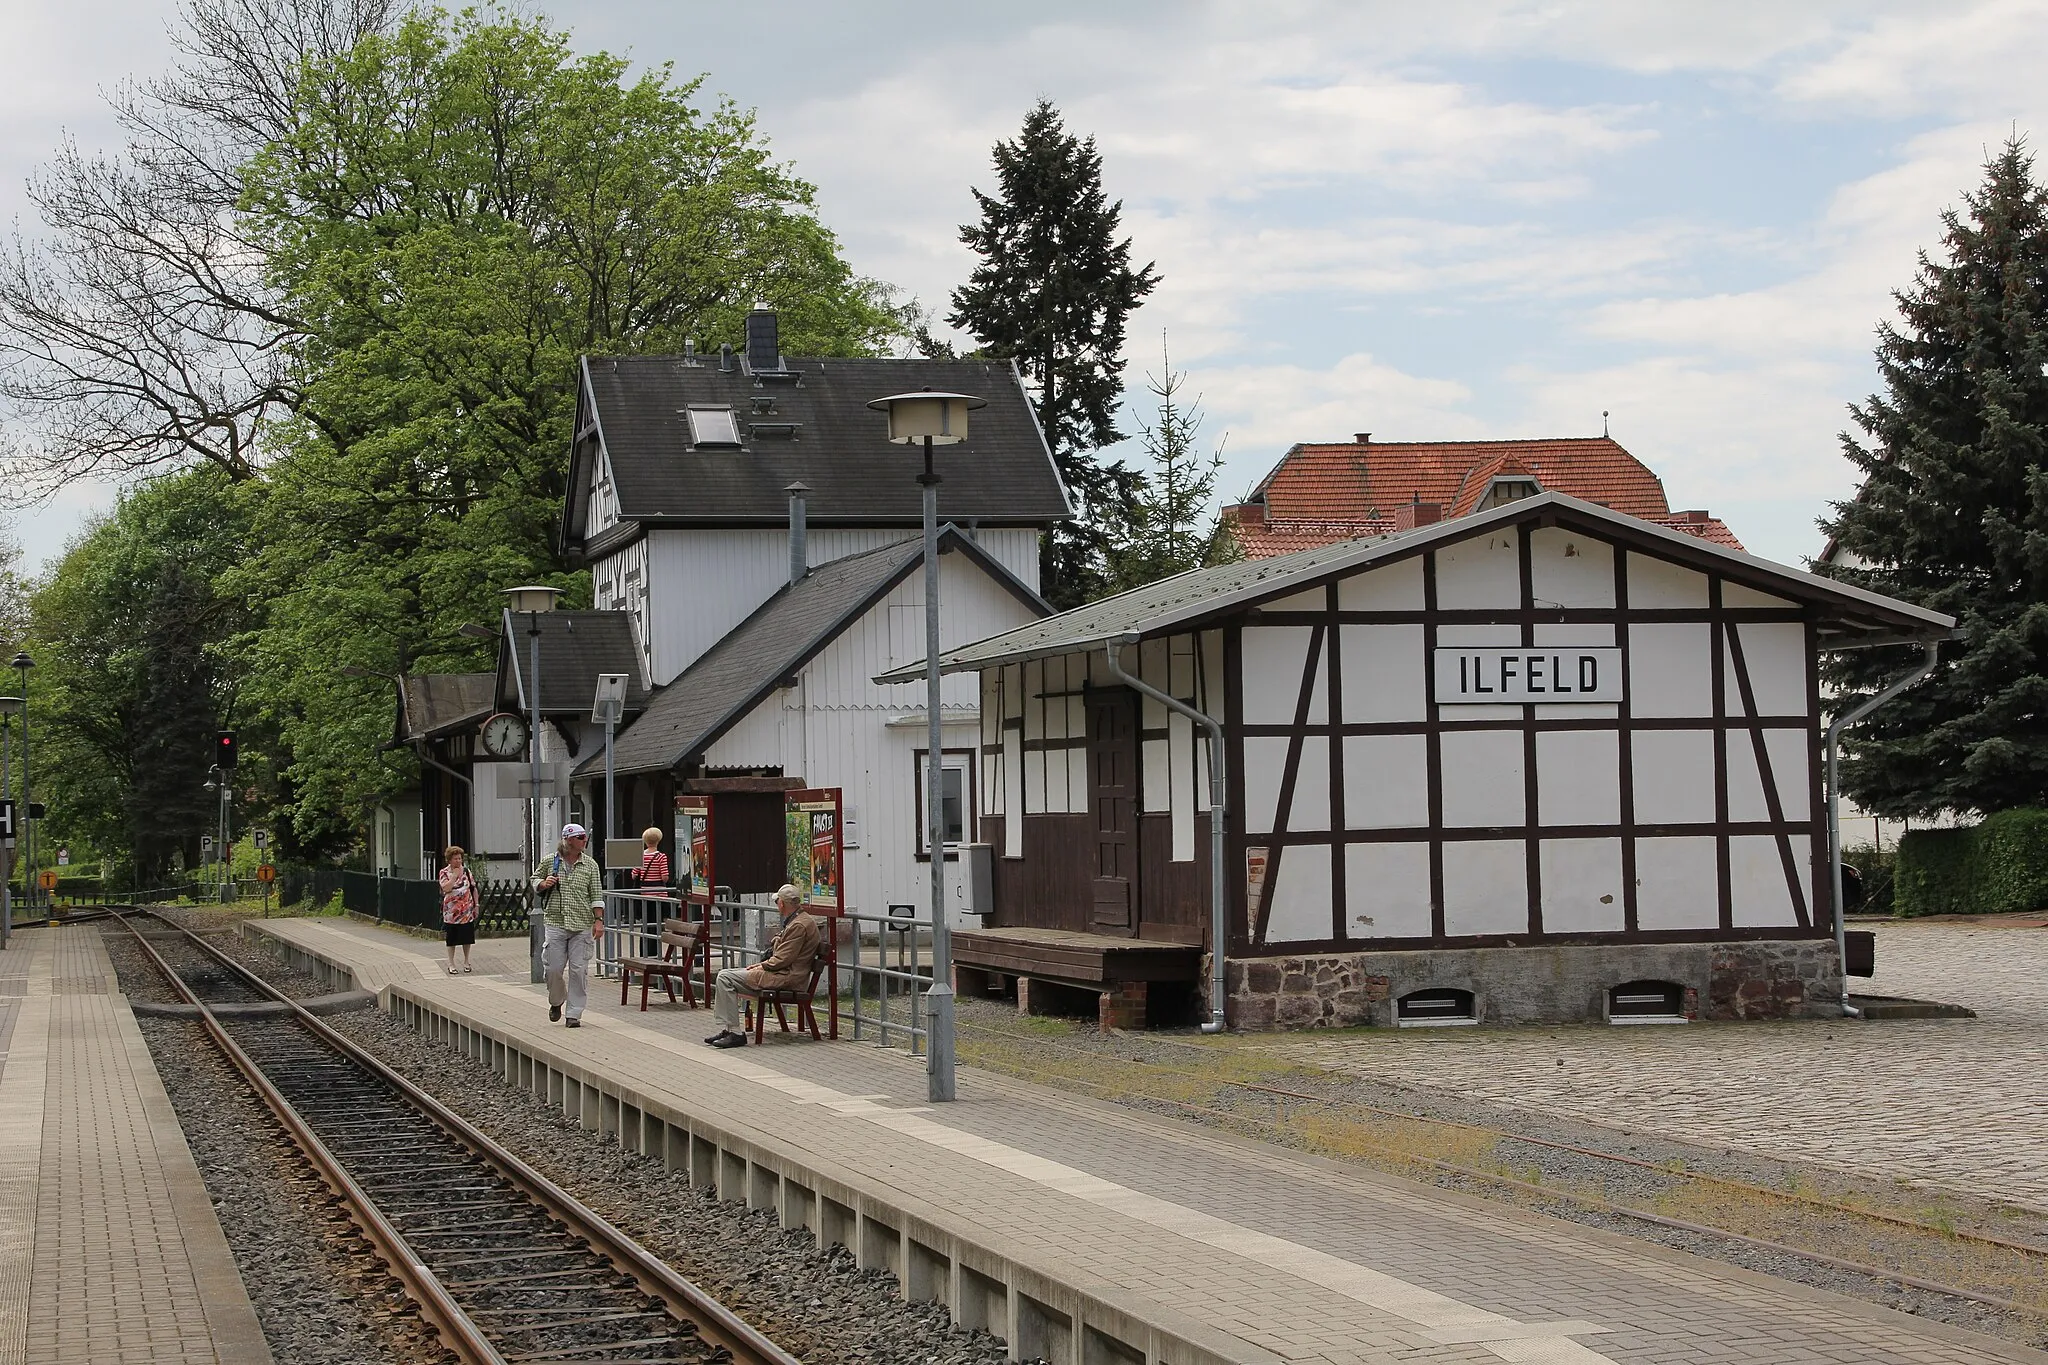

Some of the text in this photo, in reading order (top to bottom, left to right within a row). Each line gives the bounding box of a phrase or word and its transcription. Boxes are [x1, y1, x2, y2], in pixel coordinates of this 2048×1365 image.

[1460, 656, 1598, 693] ILFELD
[203, 838, 211, 850] P
[256, 832, 265, 847] P
